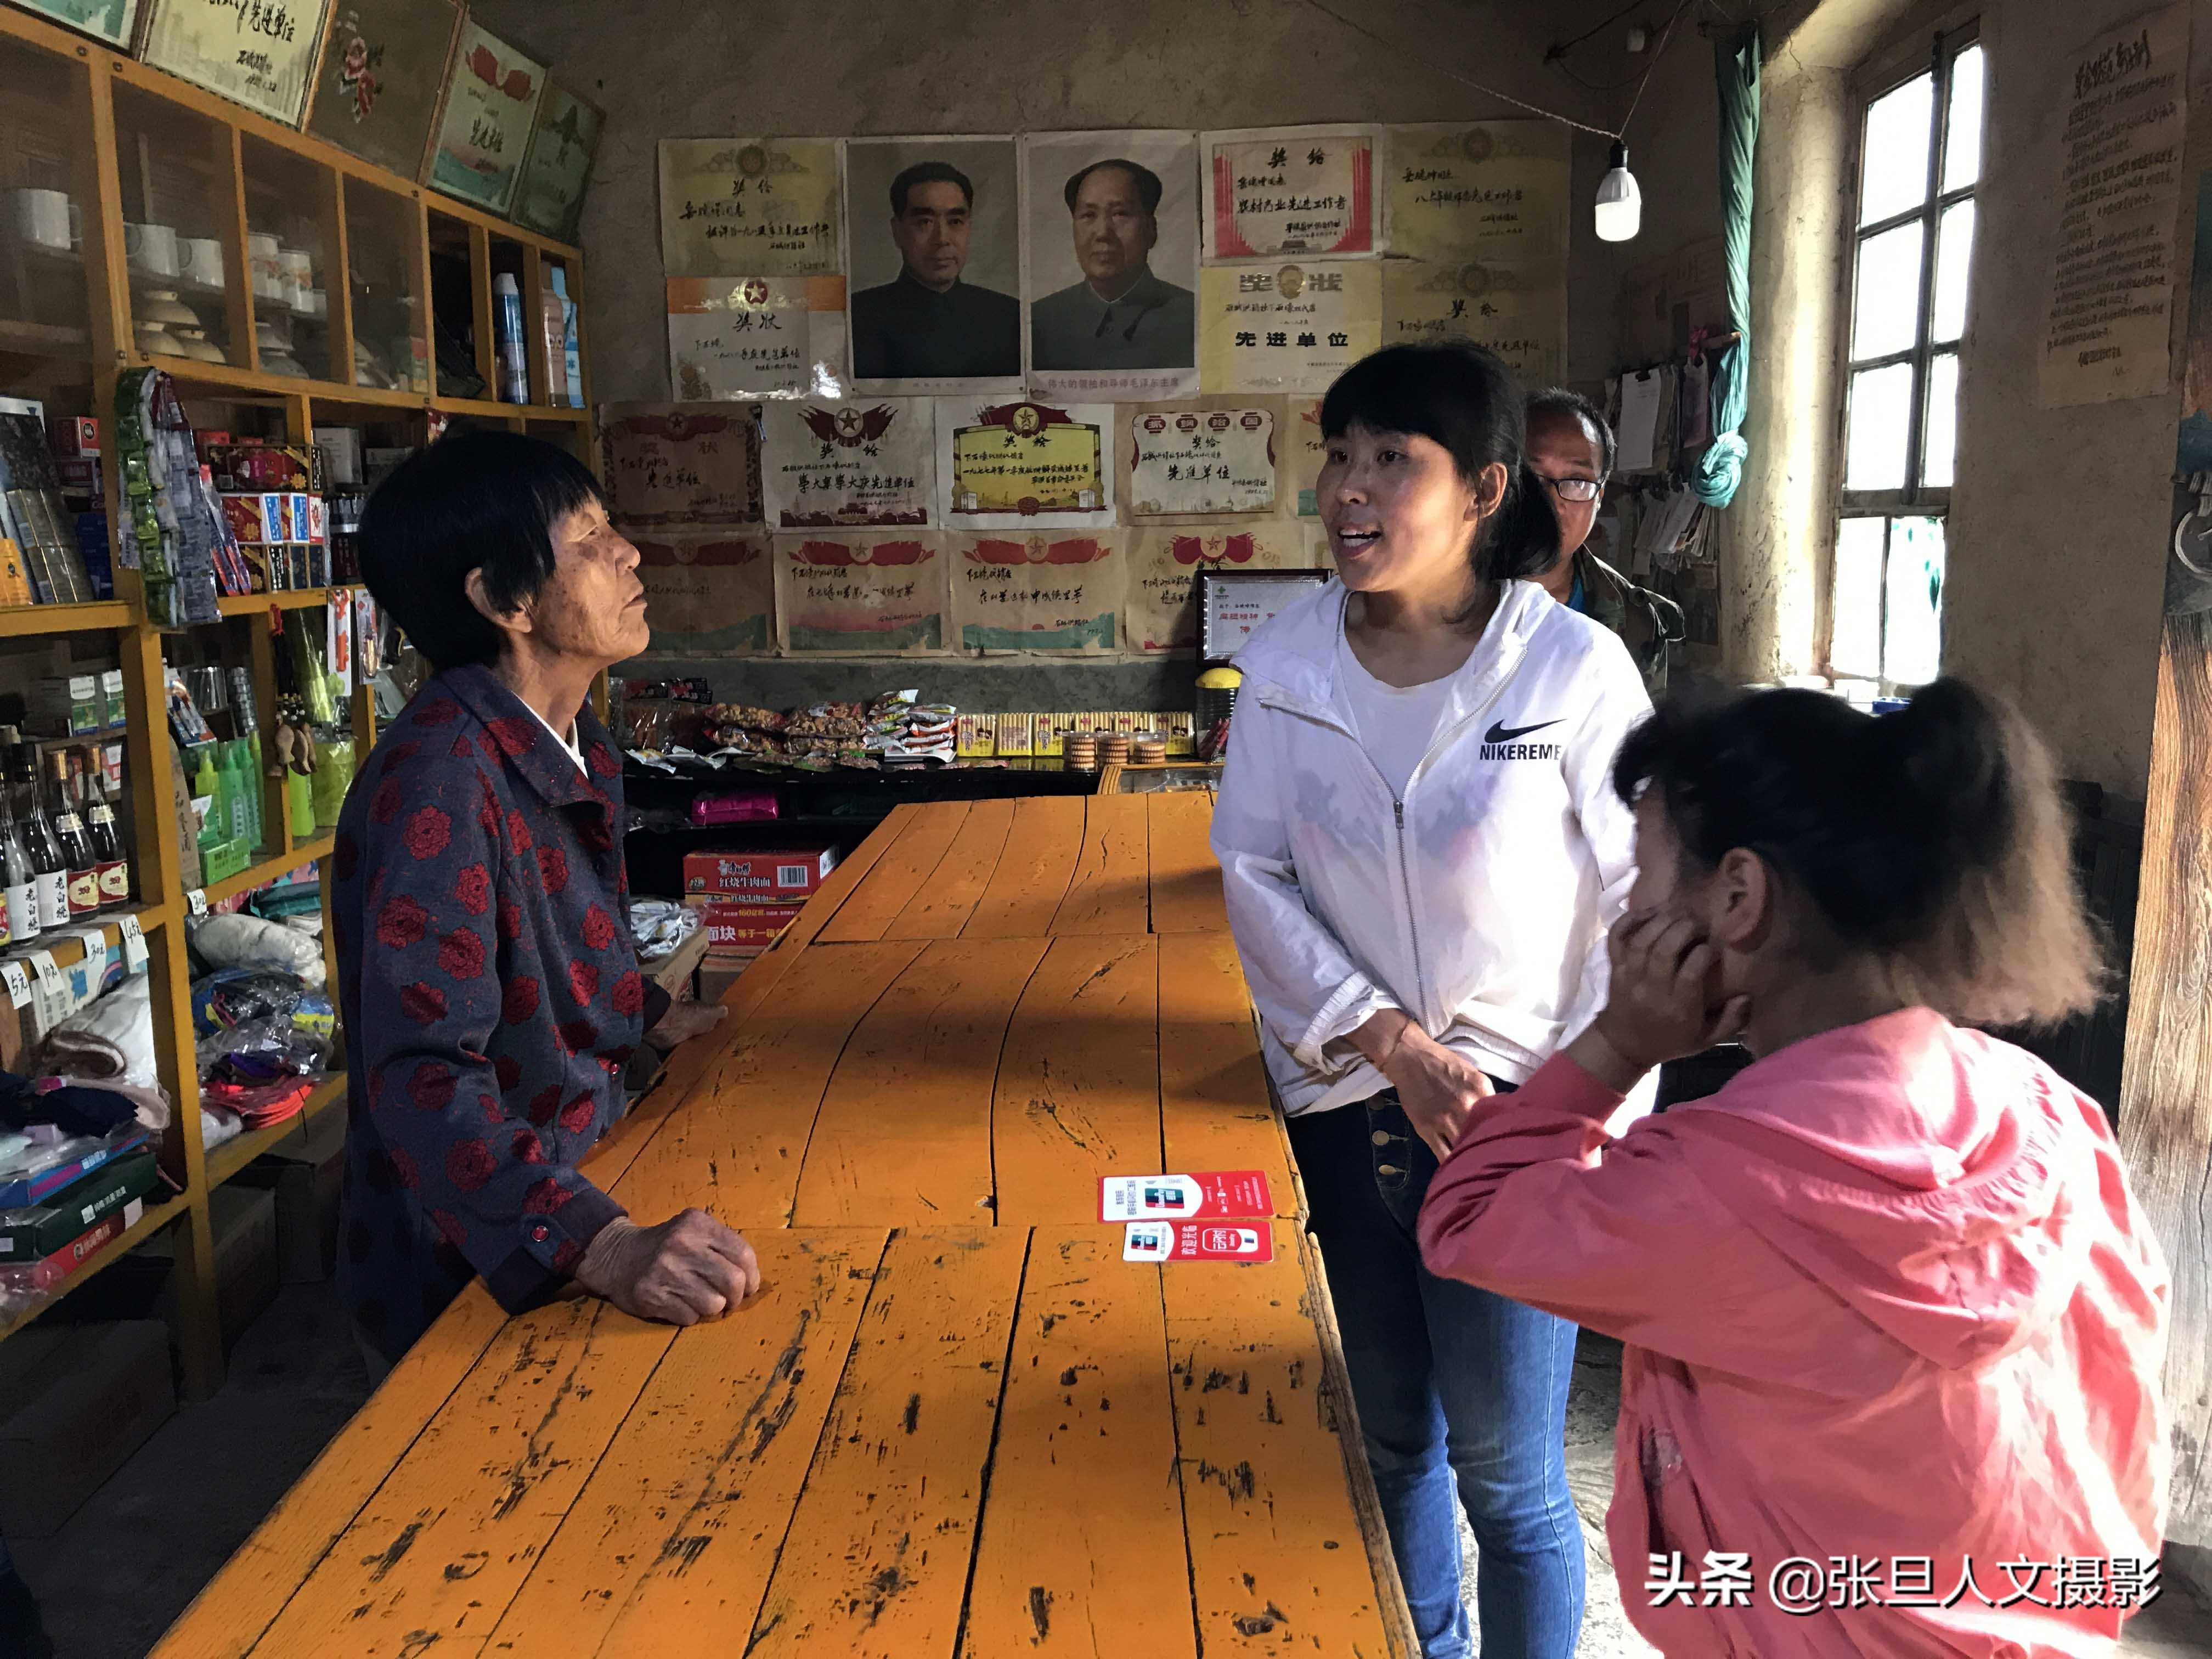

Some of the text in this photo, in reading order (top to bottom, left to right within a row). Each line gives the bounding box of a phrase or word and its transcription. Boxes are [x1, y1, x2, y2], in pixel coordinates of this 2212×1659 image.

[1267, 147, 1325, 168] 奖给
[732, 311, 783, 332] 奖状
[1235, 332, 1348, 347] 先进单位
[821, 443, 884, 459] 奖给
[1192, 435, 1220, 449] 奖给
[719, 877, 770, 887] 红烧牛肉面
[124, 920, 142, 944] 45元
[708, 926, 736, 941] 面块
[90, 943, 105, 964] 30元
[11, 972, 29, 996] 5元
[43, 963, 57, 988] 10元
[1181, 1225, 1198, 1256] 欢迎光临
[1213, 1229, 1227, 1250] 云闪付
